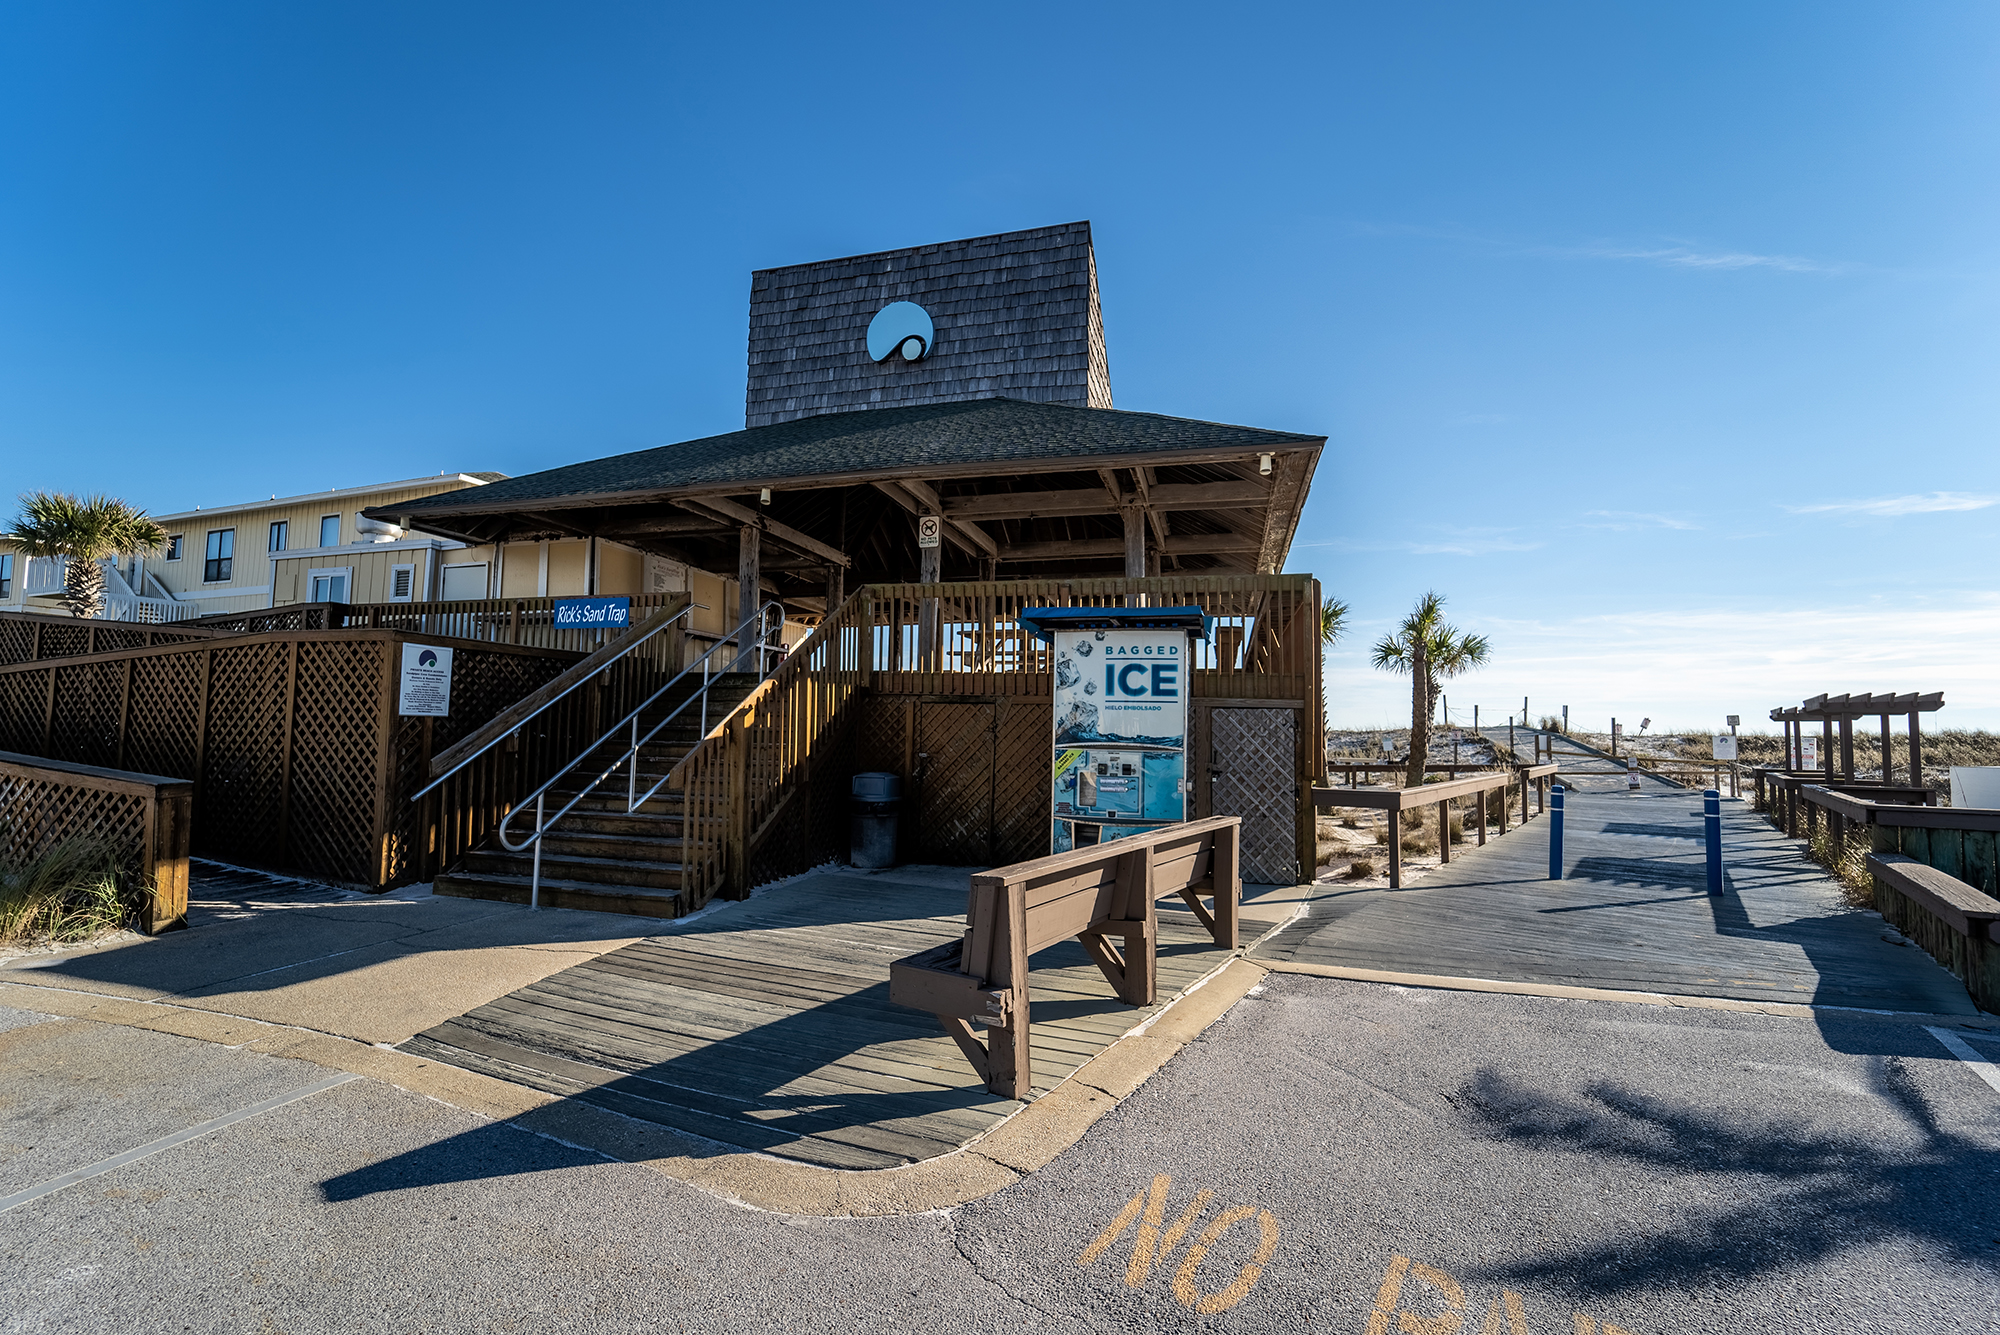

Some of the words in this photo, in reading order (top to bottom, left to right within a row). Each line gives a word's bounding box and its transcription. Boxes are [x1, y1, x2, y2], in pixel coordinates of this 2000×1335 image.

[557, 604, 582, 623] Rick's
[582, 604, 608, 622] Sand
[607, 603, 626, 624] Trap
[1105, 646, 1178, 655] BAGGED
[1105, 663, 1178, 697] ICE
[1076, 1173, 1279, 1315] NO
